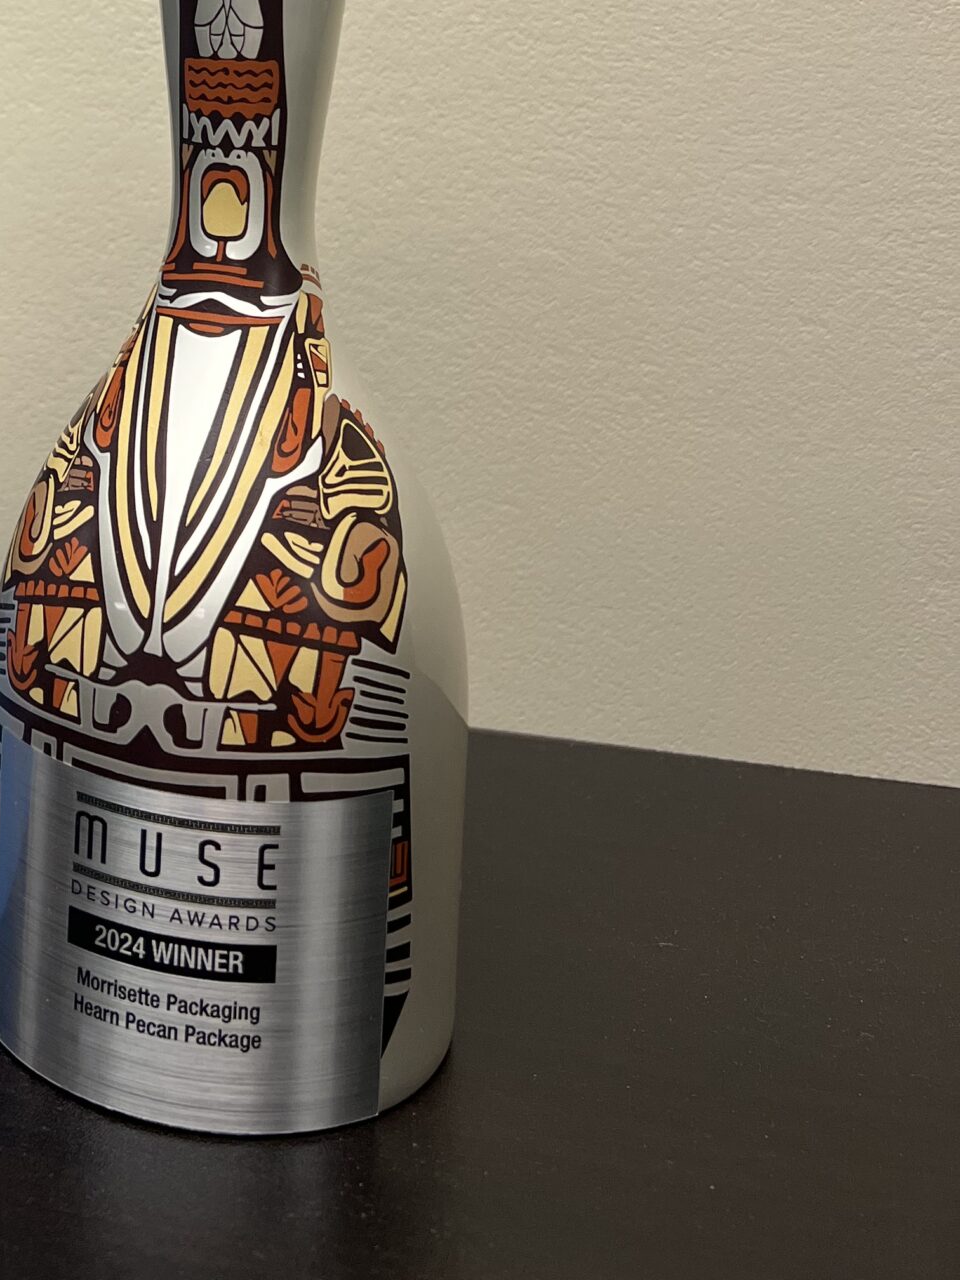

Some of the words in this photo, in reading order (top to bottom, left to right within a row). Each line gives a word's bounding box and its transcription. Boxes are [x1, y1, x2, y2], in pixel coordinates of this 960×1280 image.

[74, 810, 280, 891] MUSE
[71, 879, 155, 919] DESIGN
[169, 908, 277, 932] AWARDS
[94, 924, 146, 959] 2024
[151, 939, 244, 974] WINNER
[74, 992, 120, 1026] Hearn
[125, 1012, 179, 1041] Pecan
[184, 1025, 262, 1052] Package
[77, 966, 160, 1009] Morrisette
[166, 993, 261, 1025] Packaging
